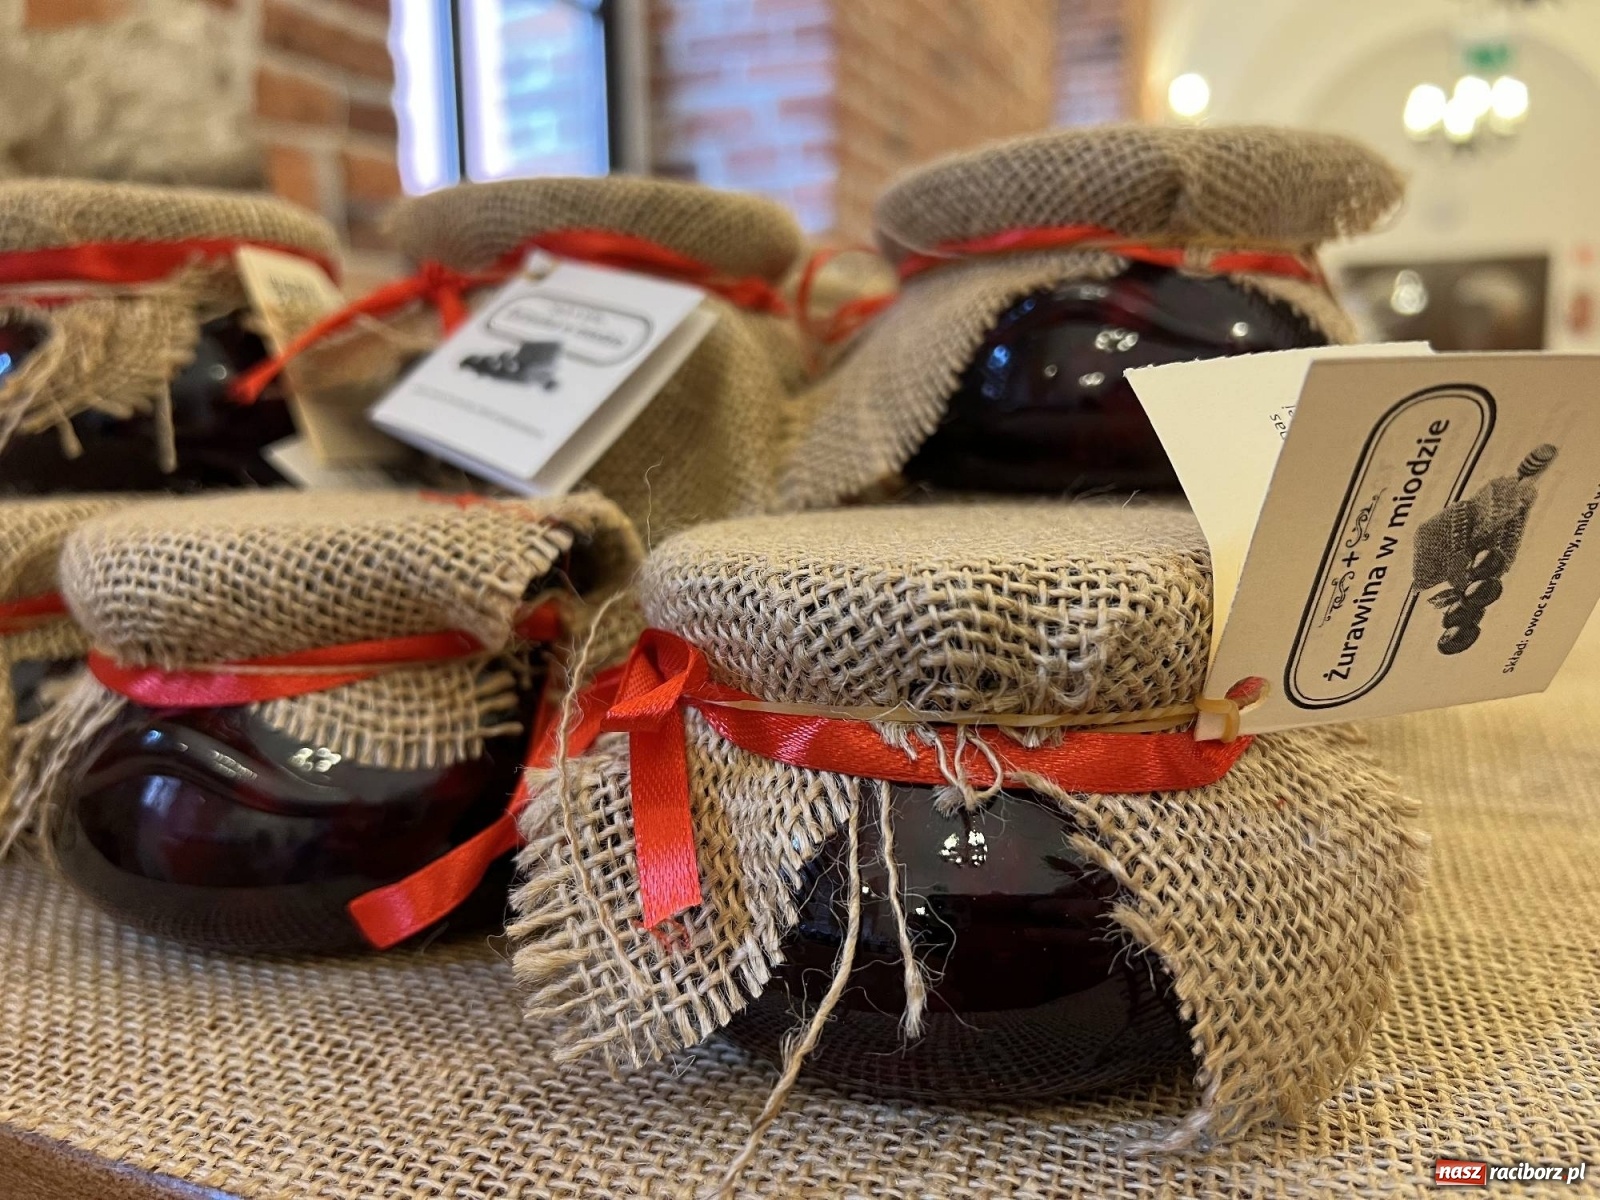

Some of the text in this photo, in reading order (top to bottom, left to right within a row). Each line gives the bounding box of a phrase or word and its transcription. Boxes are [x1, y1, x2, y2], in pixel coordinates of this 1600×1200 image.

[1322, 418, 1450, 683] Żurawina w miodzie
[1502, 502, 1599, 674] Skład: owoc żurawiny, miód
